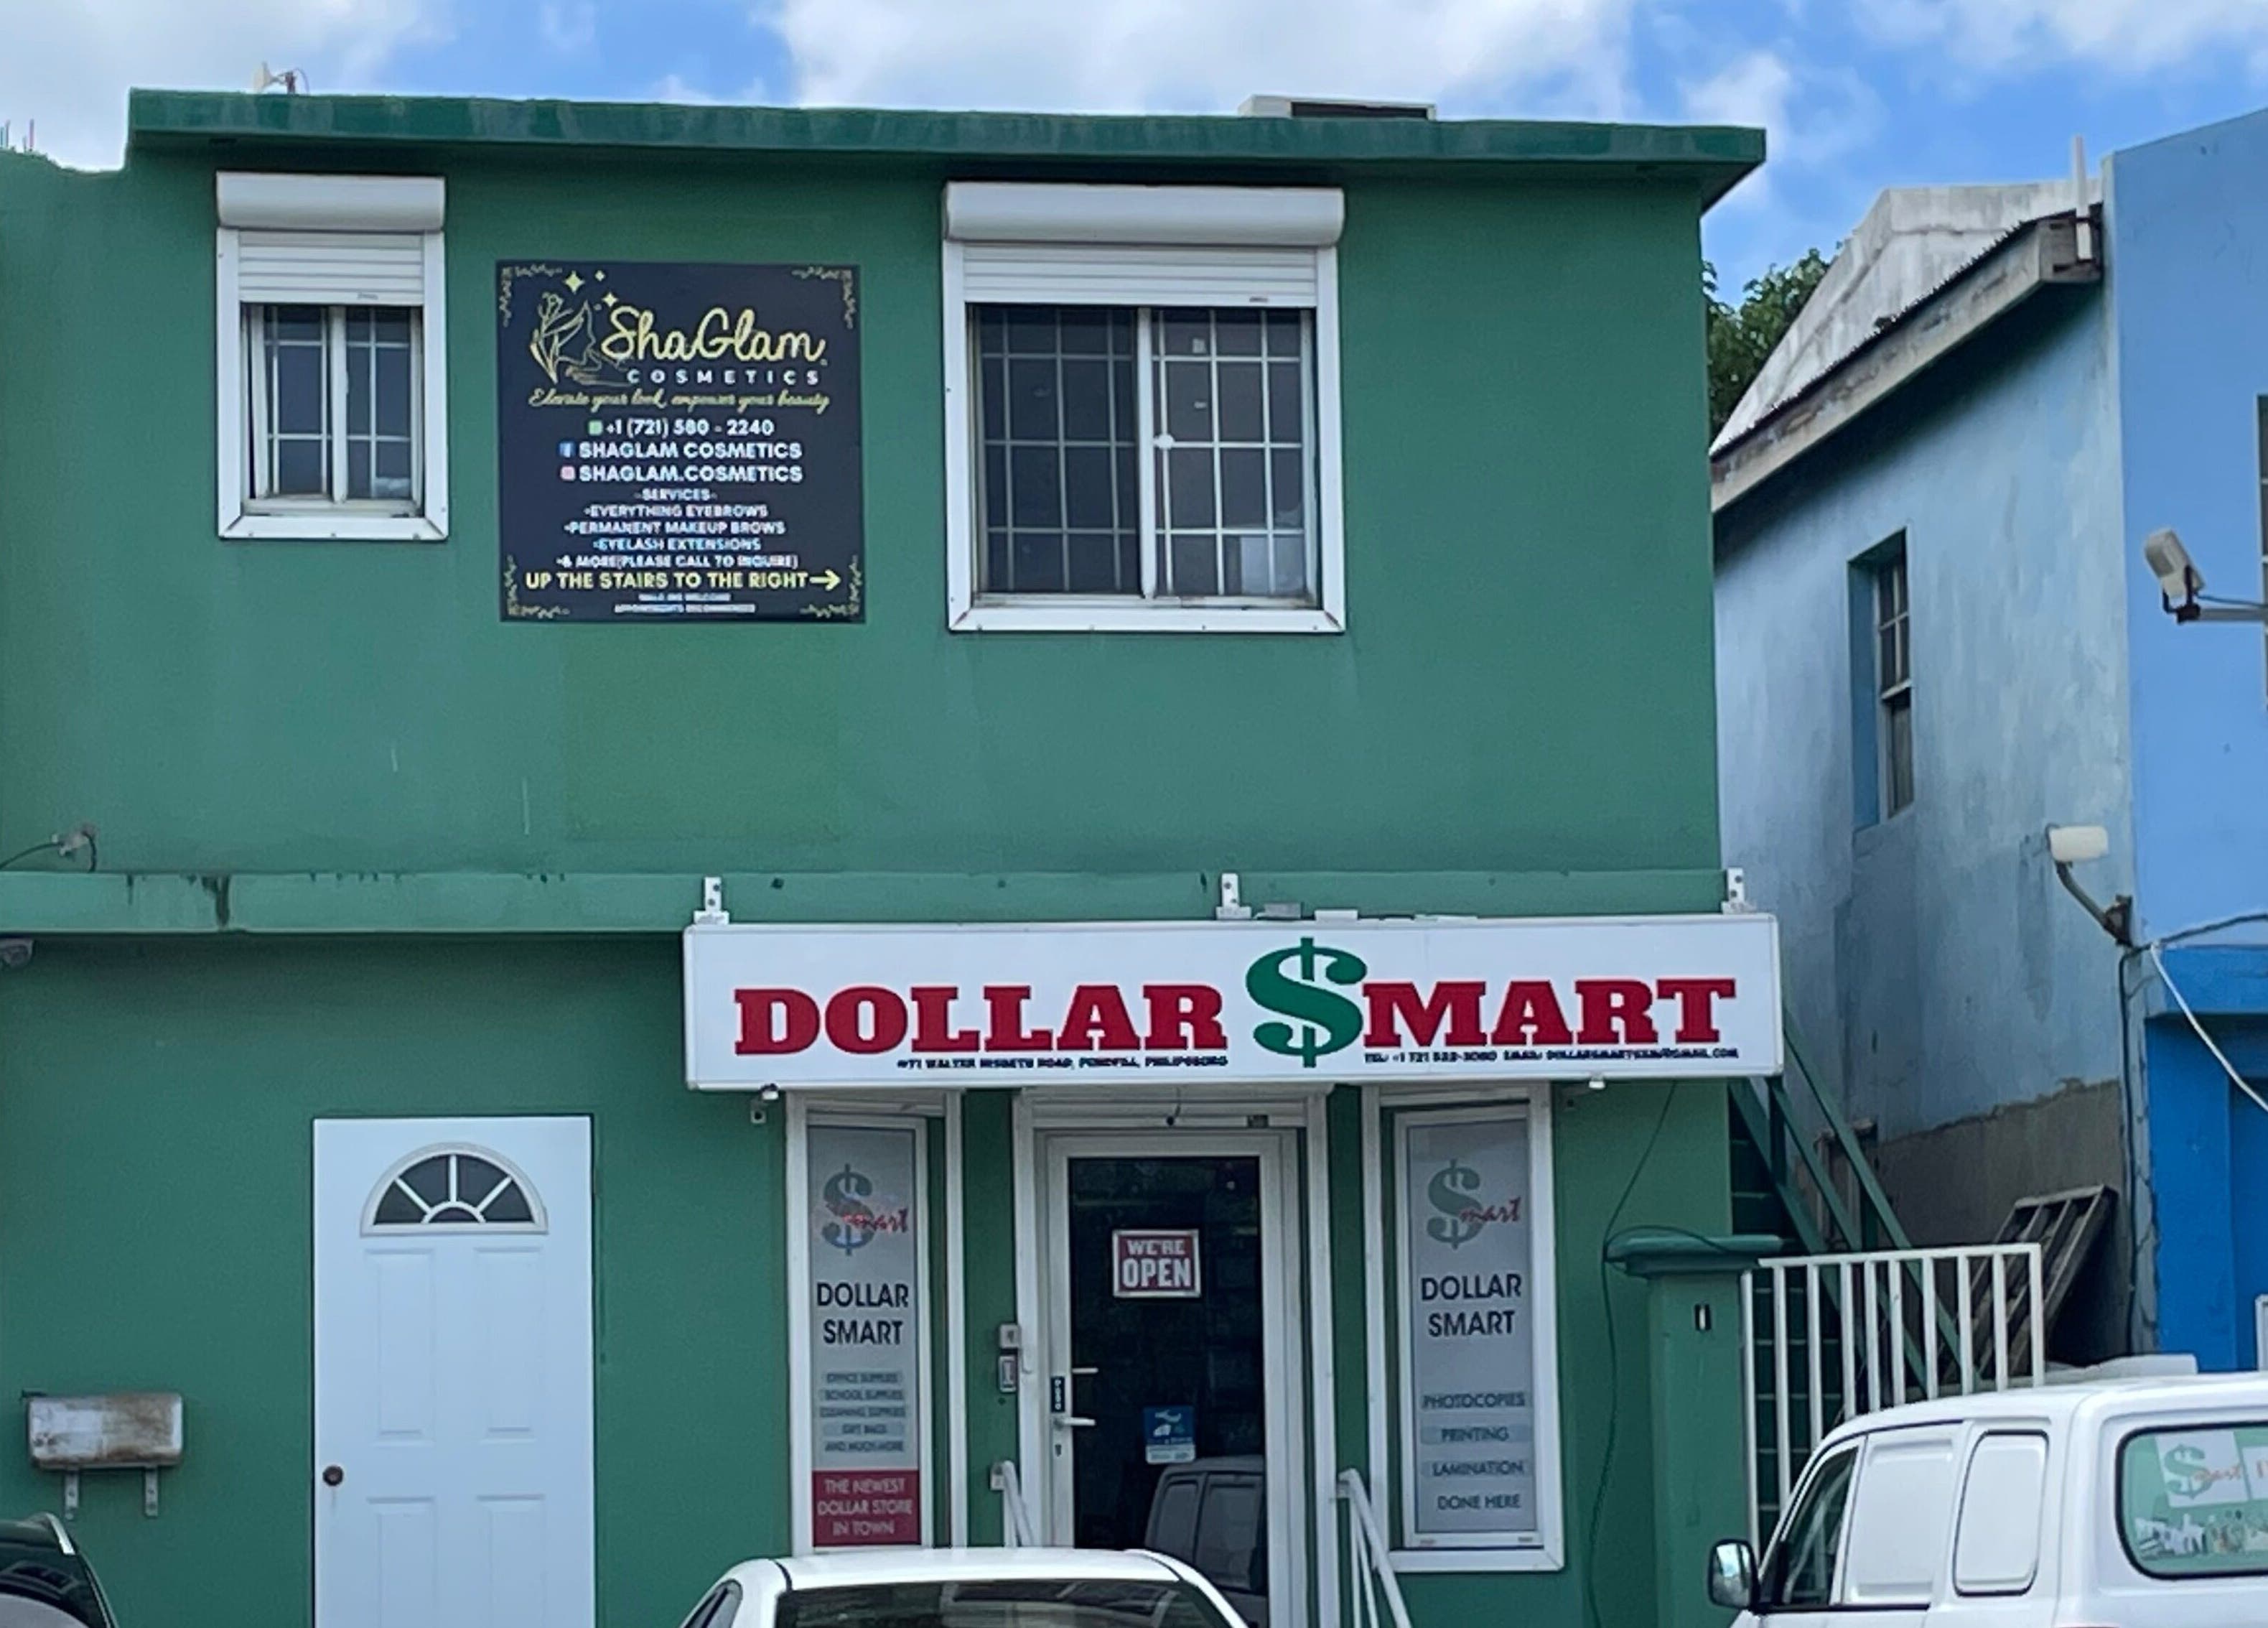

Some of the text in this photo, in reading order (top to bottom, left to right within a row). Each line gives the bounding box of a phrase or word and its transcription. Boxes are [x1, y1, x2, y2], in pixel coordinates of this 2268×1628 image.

[601, 306, 826, 361] ShaGlam
[627, 369, 819, 385] COSMETICS
[590, 394, 628, 413] your
[606, 419, 622, 435] +1
[627, 418, 669, 439] (721)
[727, 419, 775, 436] 2240
[579, 442, 803, 459] SHAGLAM COSMETICS
[579, 465, 803, 483] SHAGLAM.COSMETICS
[686, 505, 768, 517] EYEBROWS
[665, 521, 728, 534] MAKEUP
[730, 521, 785, 534] BROWS
[668, 538, 761, 551] EXTENSIONS
[675, 556, 712, 568] CALL
[715, 556, 734, 568] TO
[526, 572, 809, 590] UP THE STAIRS TO THE RIGHT
[734, 984, 1228, 1055] DOLLAR
[1127, 1239, 1185, 1255] WE'RE
[1123, 1257, 1192, 1288] OPEN
[817, 1282, 909, 1308] DOLLAR
[1421, 1273, 1522, 1301] DOLLAR
[823, 1318, 903, 1345] SMART
[1428, 1311, 1516, 1337] SMART
[825, 1477, 905, 1494] THE NEWEST
[817, 1499, 913, 1515] DOLLAR STORE
[1437, 1494, 1521, 1510] DONE HERE
[833, 1520, 895, 1536] IN TOWN
